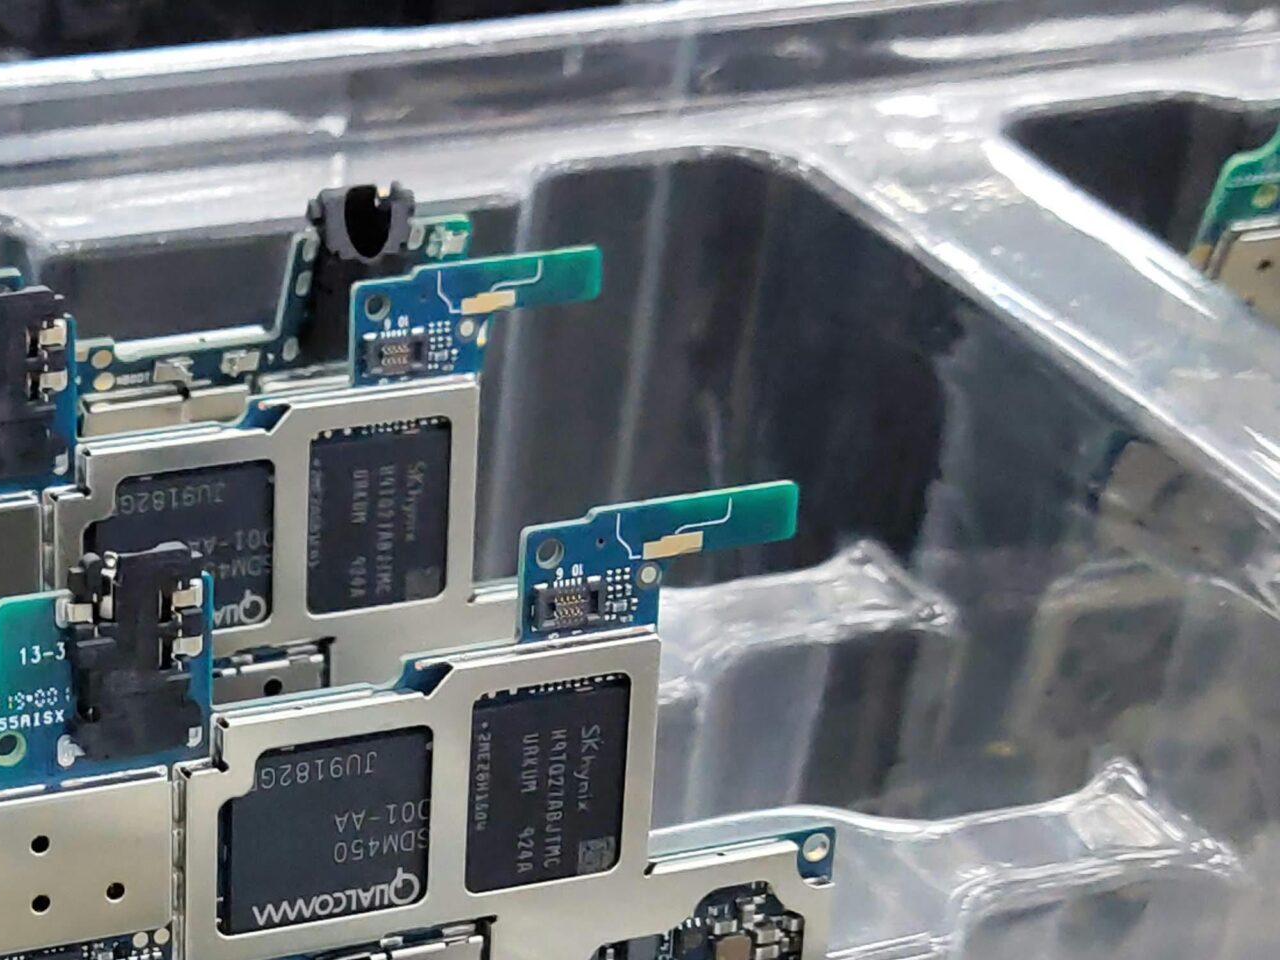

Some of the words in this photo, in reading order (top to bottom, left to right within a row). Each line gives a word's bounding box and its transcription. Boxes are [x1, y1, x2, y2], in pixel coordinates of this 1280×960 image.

[20, 641, 66, 665] 13-3
[252, 751, 378, 792] JU9182G
[252, 867, 420, 926] QUALCOMM
